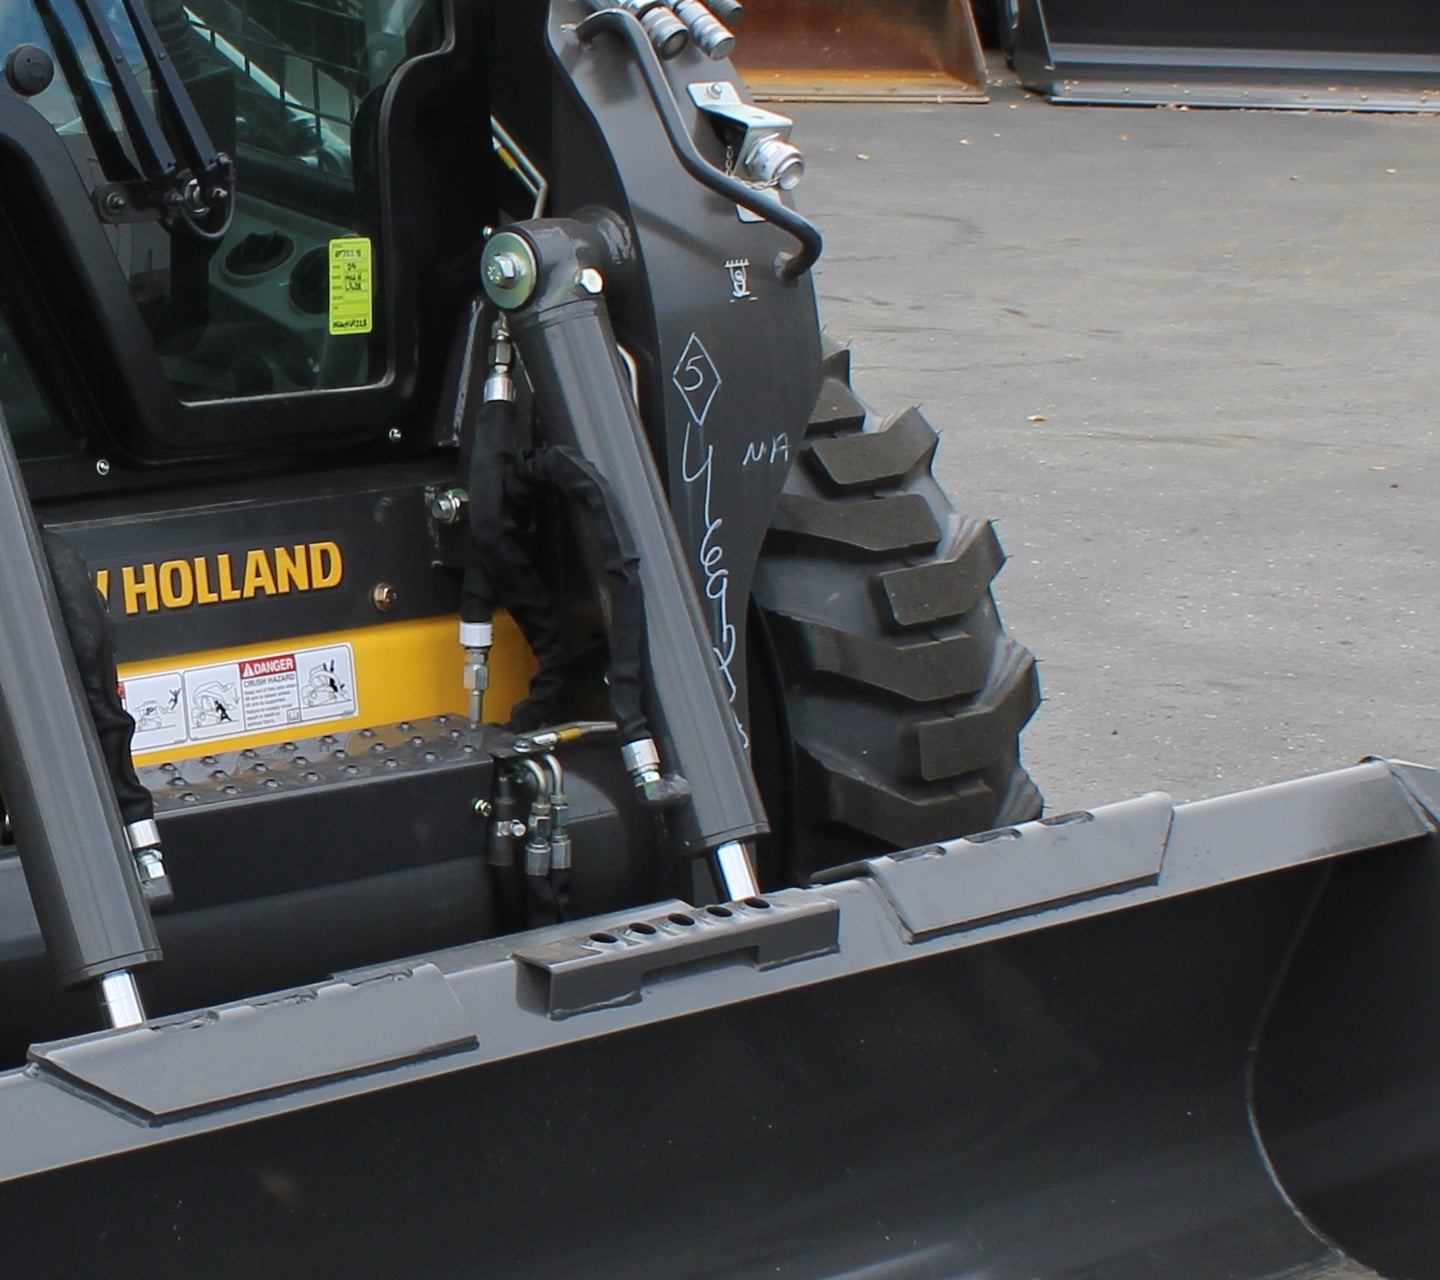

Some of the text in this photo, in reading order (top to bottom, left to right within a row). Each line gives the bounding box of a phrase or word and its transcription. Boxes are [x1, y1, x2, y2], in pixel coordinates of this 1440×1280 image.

[684, 353, 706, 392] 5
[122, 540, 345, 615] HOLLAND
[253, 657, 294, 675] DANGER
[244, 673, 295, 689] CRUSH HAZARD
